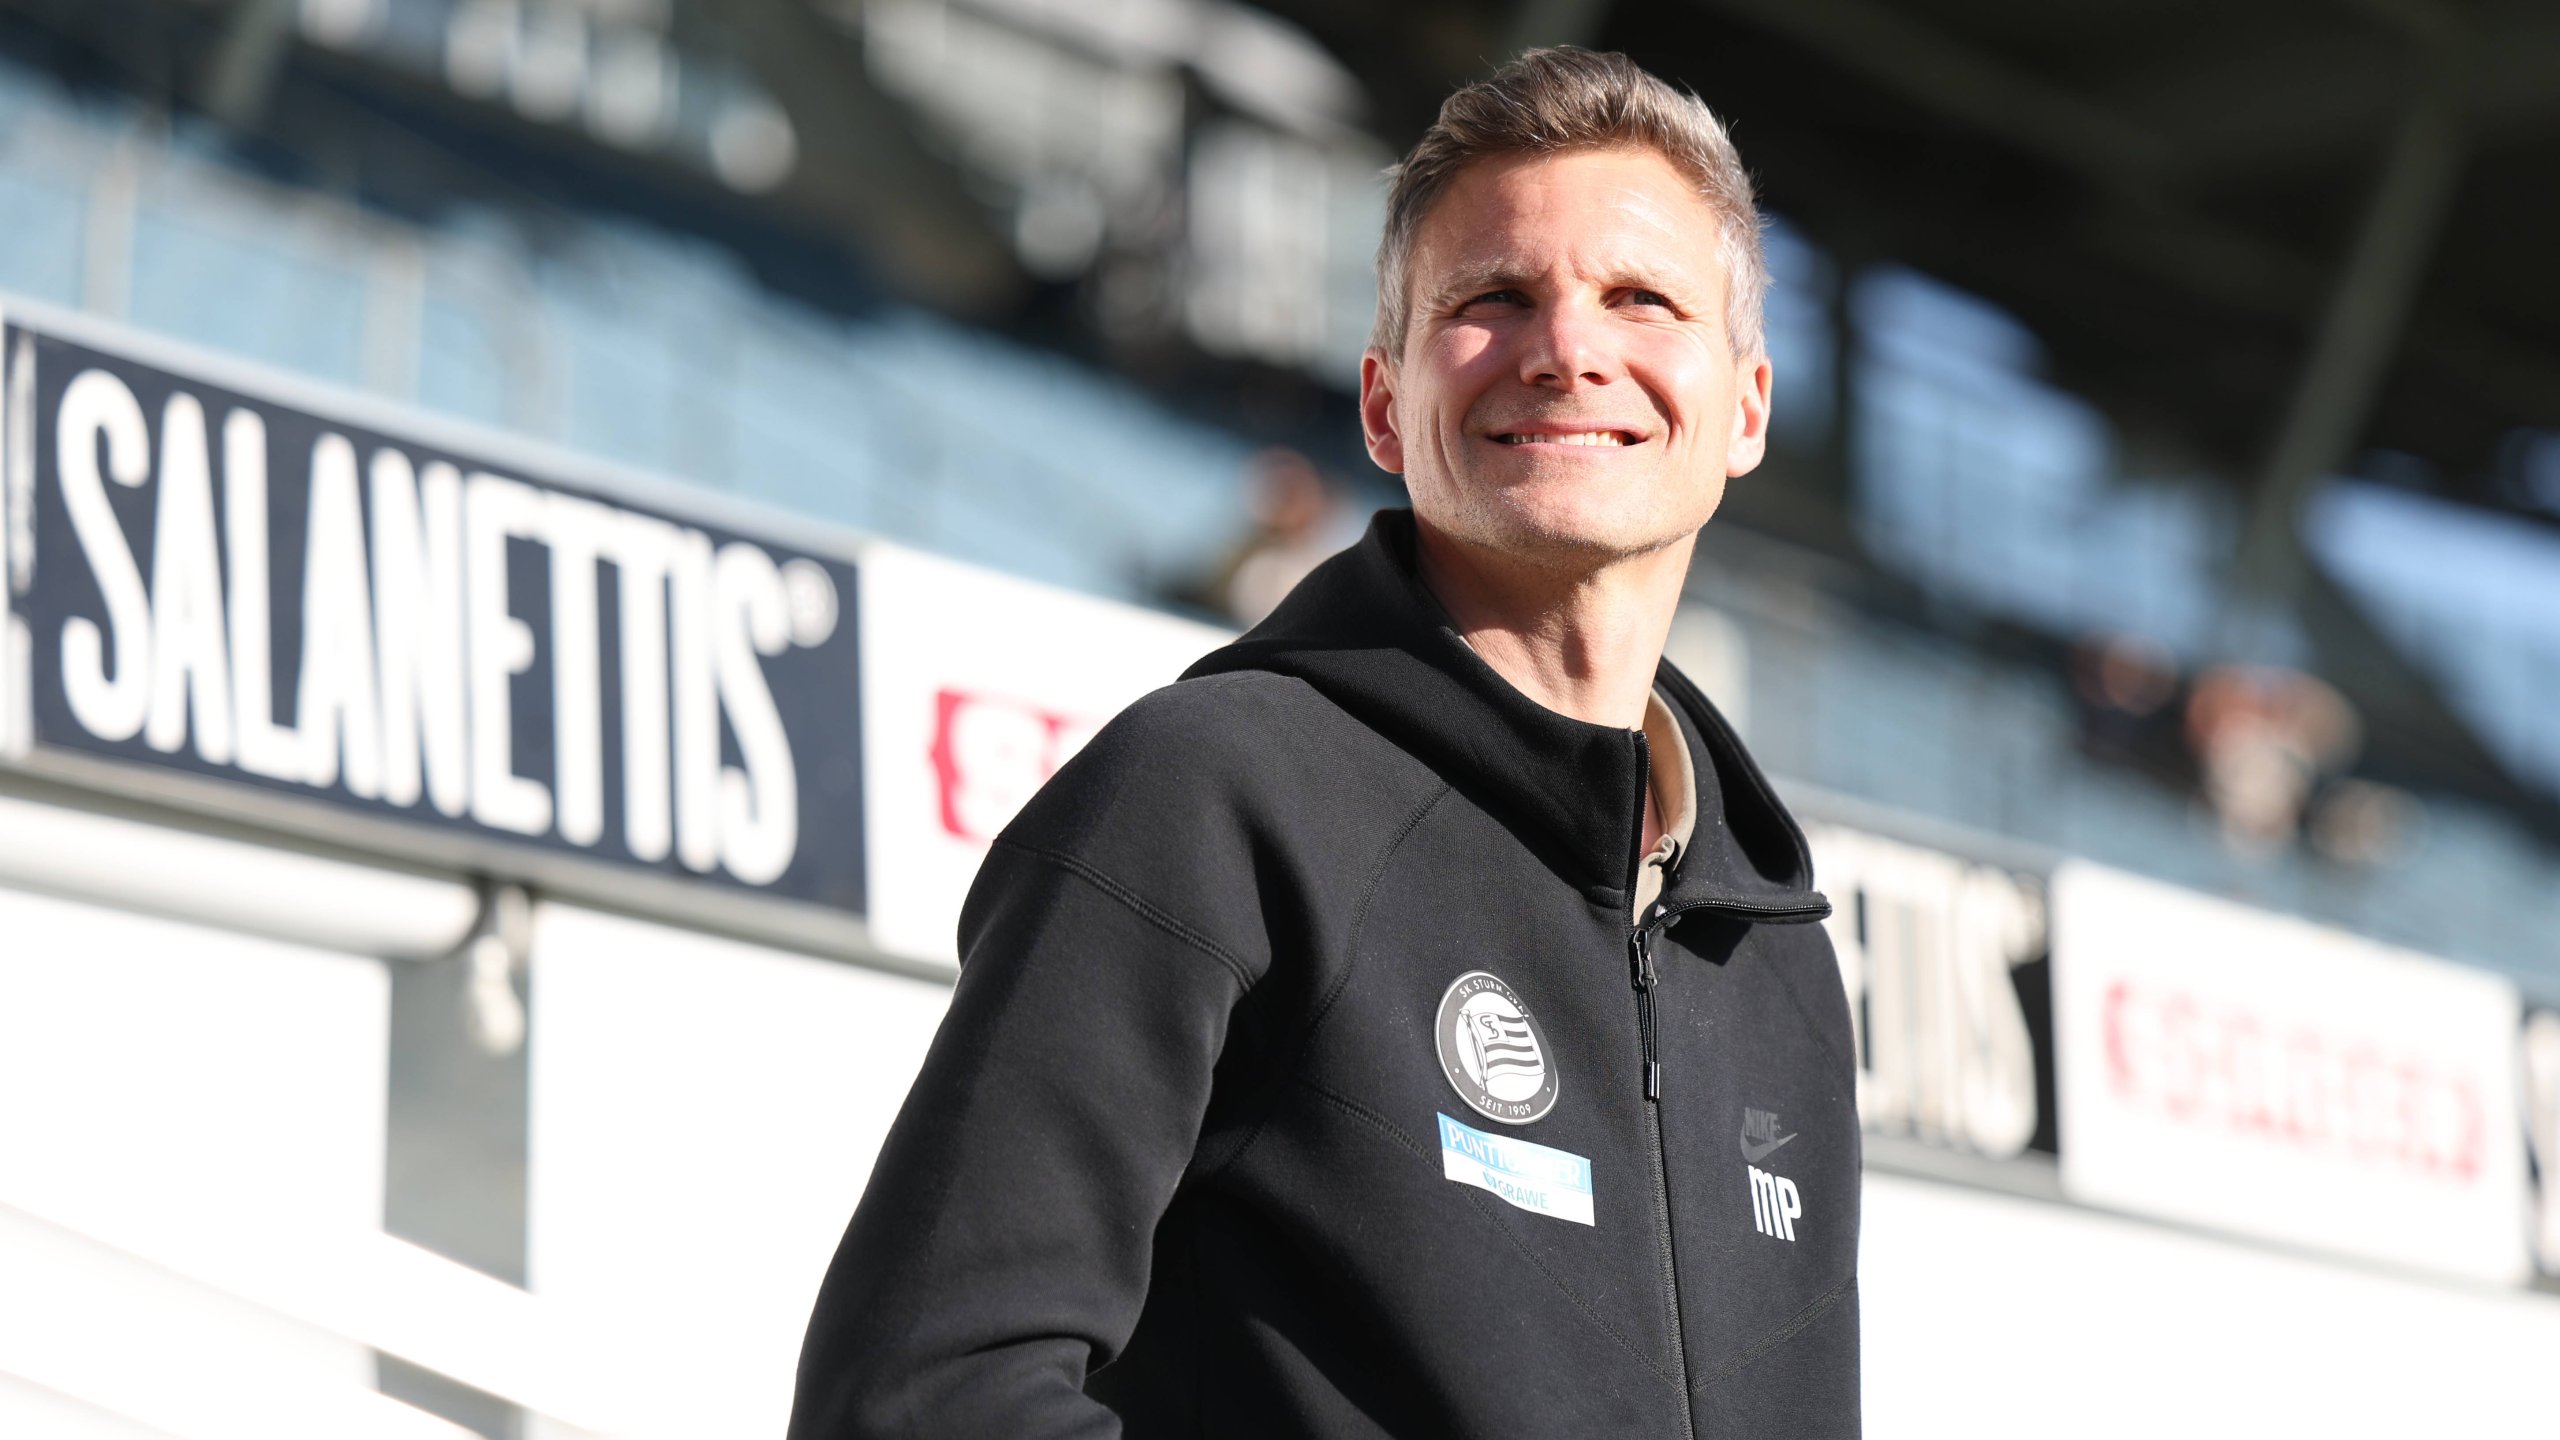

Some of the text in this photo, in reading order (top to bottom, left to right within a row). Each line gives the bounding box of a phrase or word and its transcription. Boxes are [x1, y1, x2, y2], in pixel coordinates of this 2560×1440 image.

[56, 368, 799, 885] SALANETTIS
[1459, 984, 1473, 998] SK
[1480, 1095, 1531, 1117] SEIT 1909
[1744, 1107, 1779, 1143] NIKE
[1498, 1180, 1549, 1210] GRAWE
